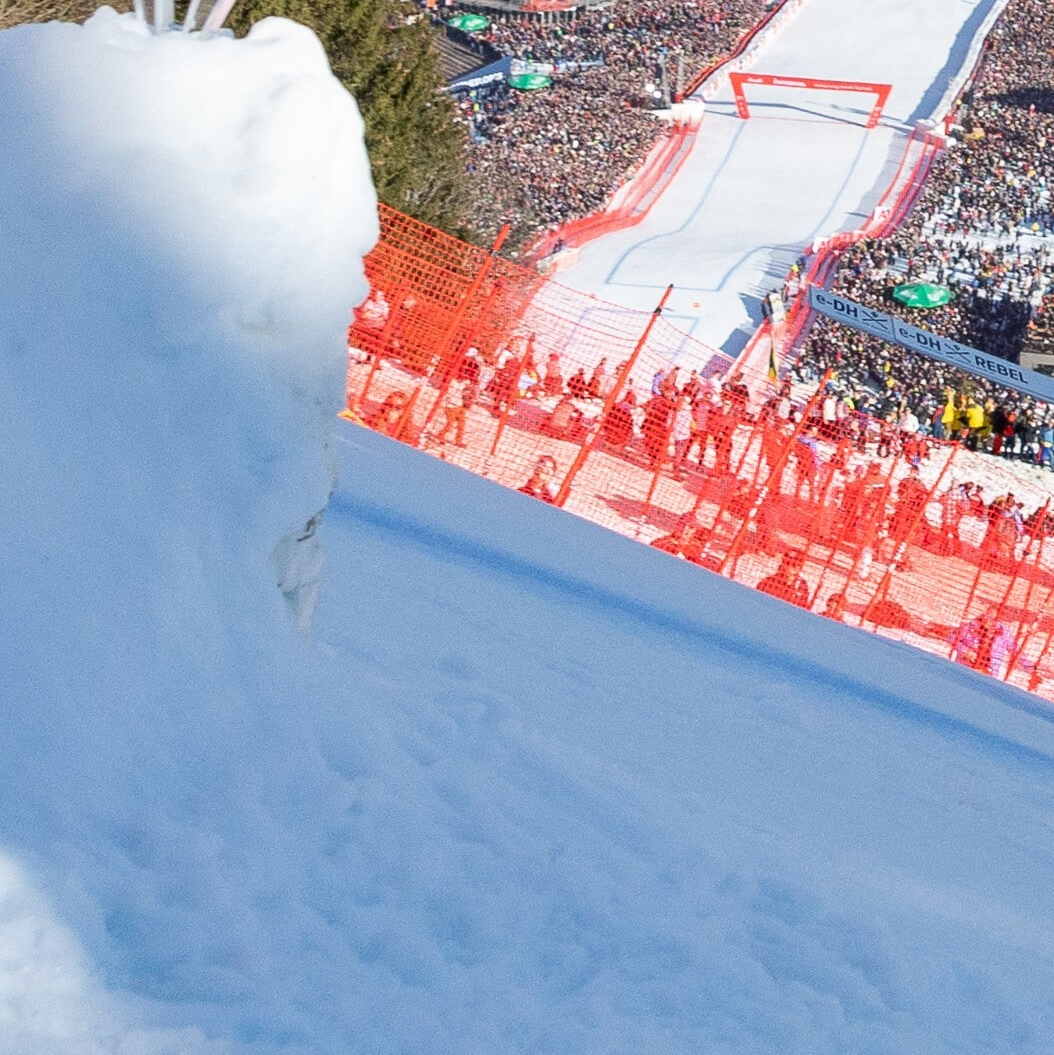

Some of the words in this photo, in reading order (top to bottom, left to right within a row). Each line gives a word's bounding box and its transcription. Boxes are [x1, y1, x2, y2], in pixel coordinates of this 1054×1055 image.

[816, 294, 859, 318] e-DH
[899, 328, 941, 351] e-DH
[974, 354, 1029, 385] REBEL
